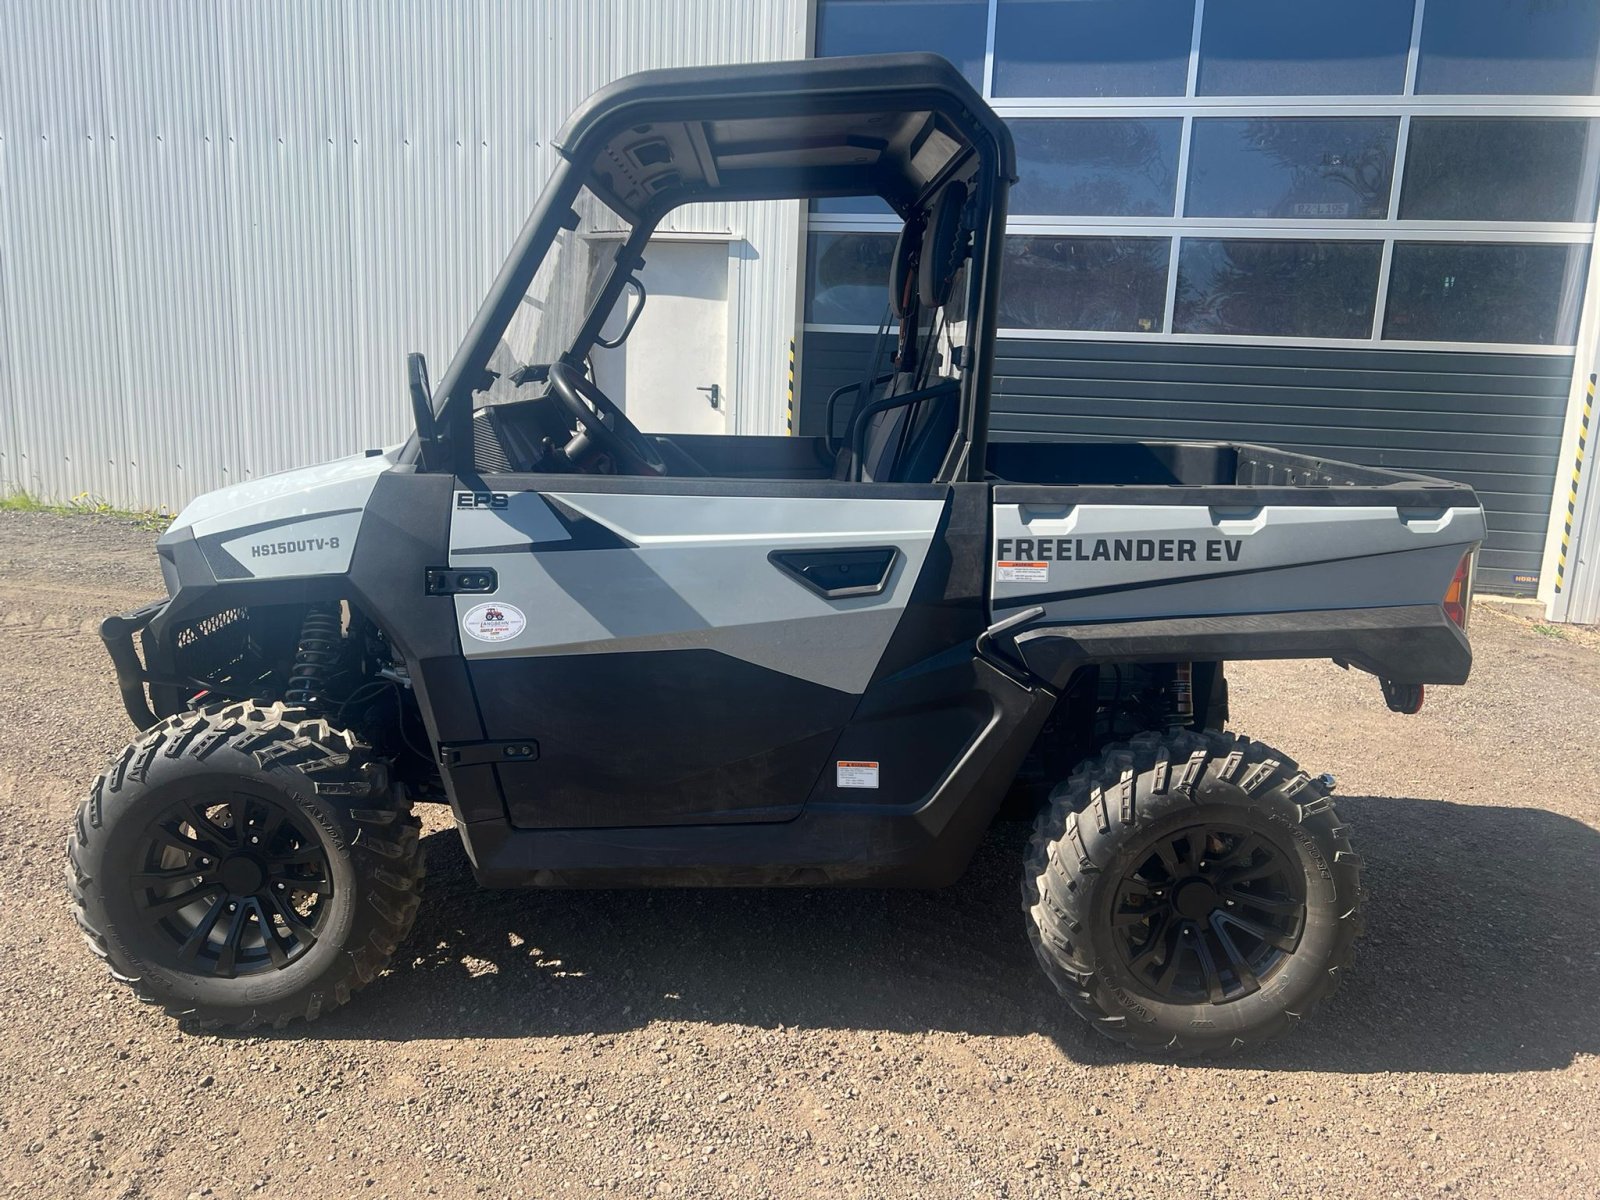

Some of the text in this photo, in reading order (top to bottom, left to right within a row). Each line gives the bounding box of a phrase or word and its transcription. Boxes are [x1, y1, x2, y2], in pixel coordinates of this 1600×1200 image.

[457, 493, 509, 507] EPS
[251, 537, 340, 558] HS15DUTV-8
[997, 538, 1243, 562] FREELANDER EV
